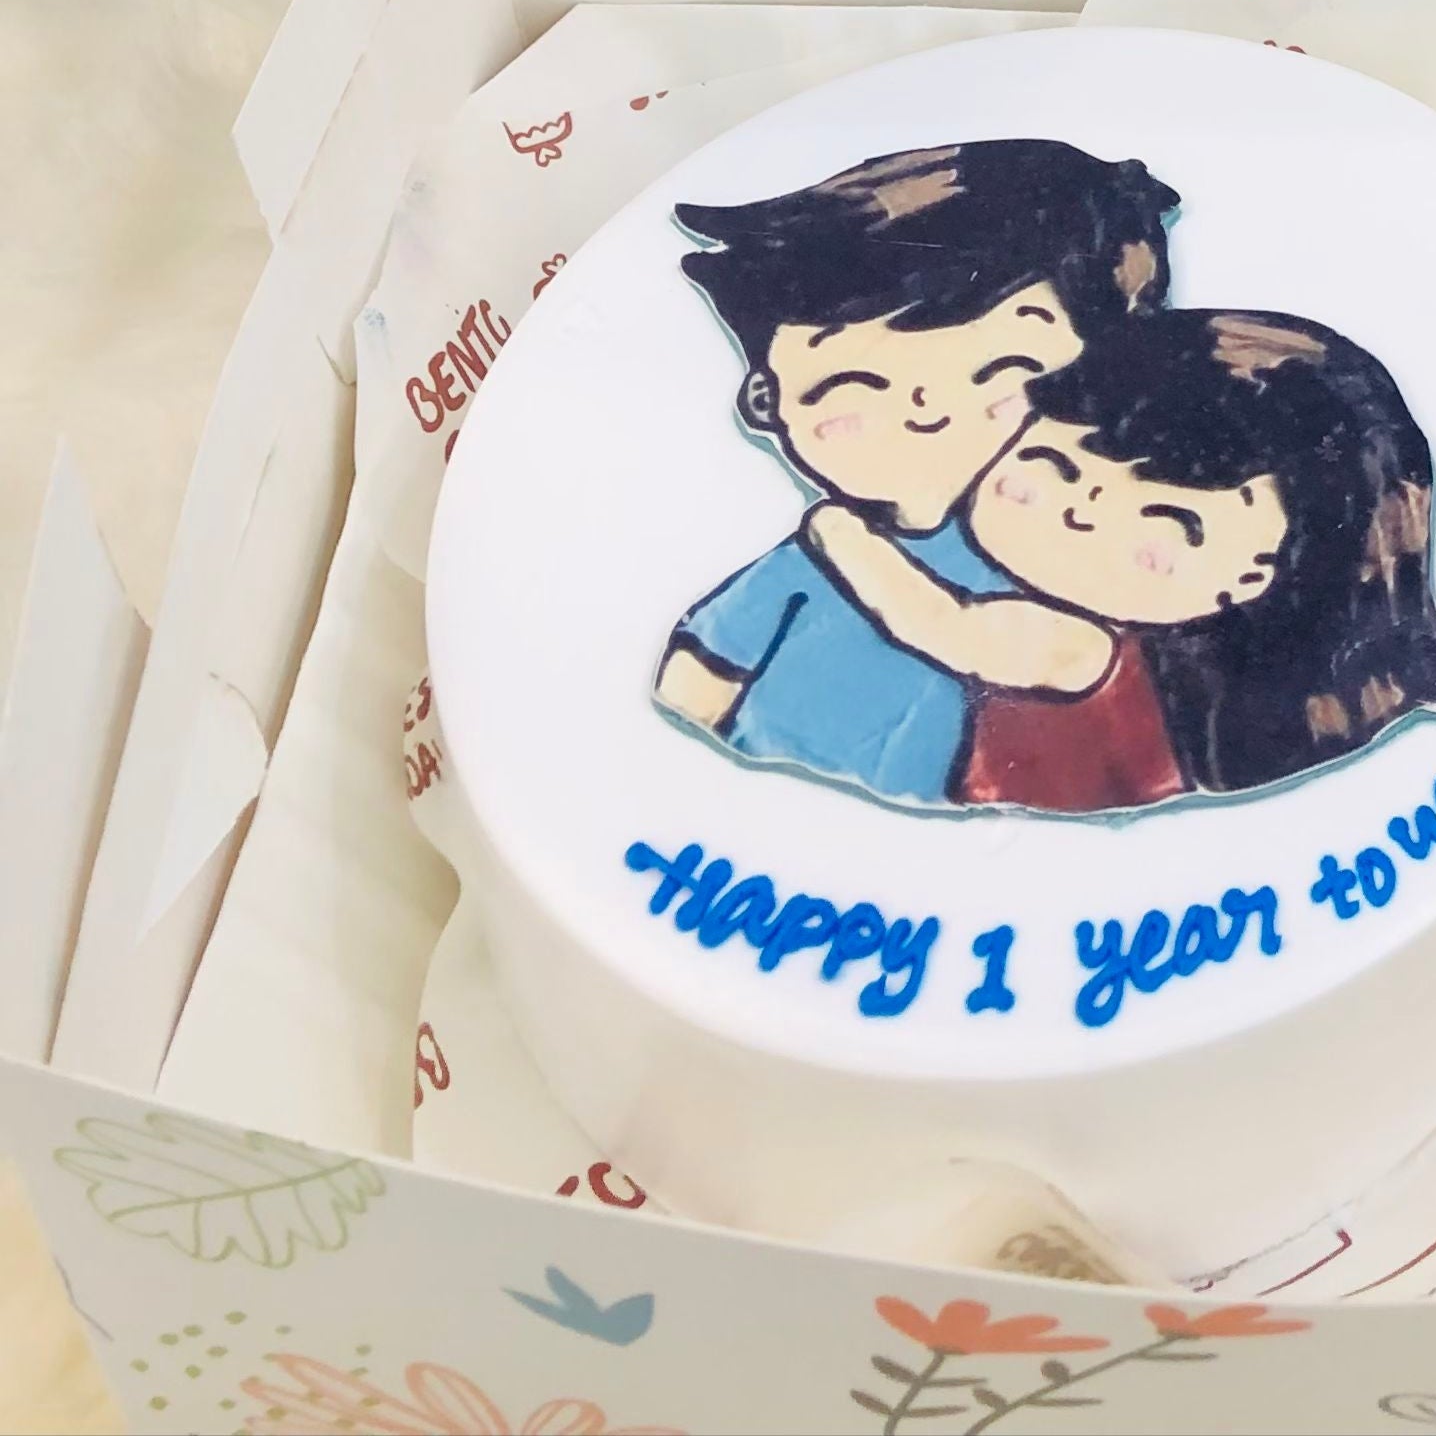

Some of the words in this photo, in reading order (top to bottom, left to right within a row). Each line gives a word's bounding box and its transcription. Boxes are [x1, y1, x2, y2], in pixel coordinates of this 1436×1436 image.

[625, 840, 942, 1019] Happy
[964, 924, 1018, 1016] 1
[1073, 885, 1284, 1029] year
[1308, 846, 1399, 921] to
